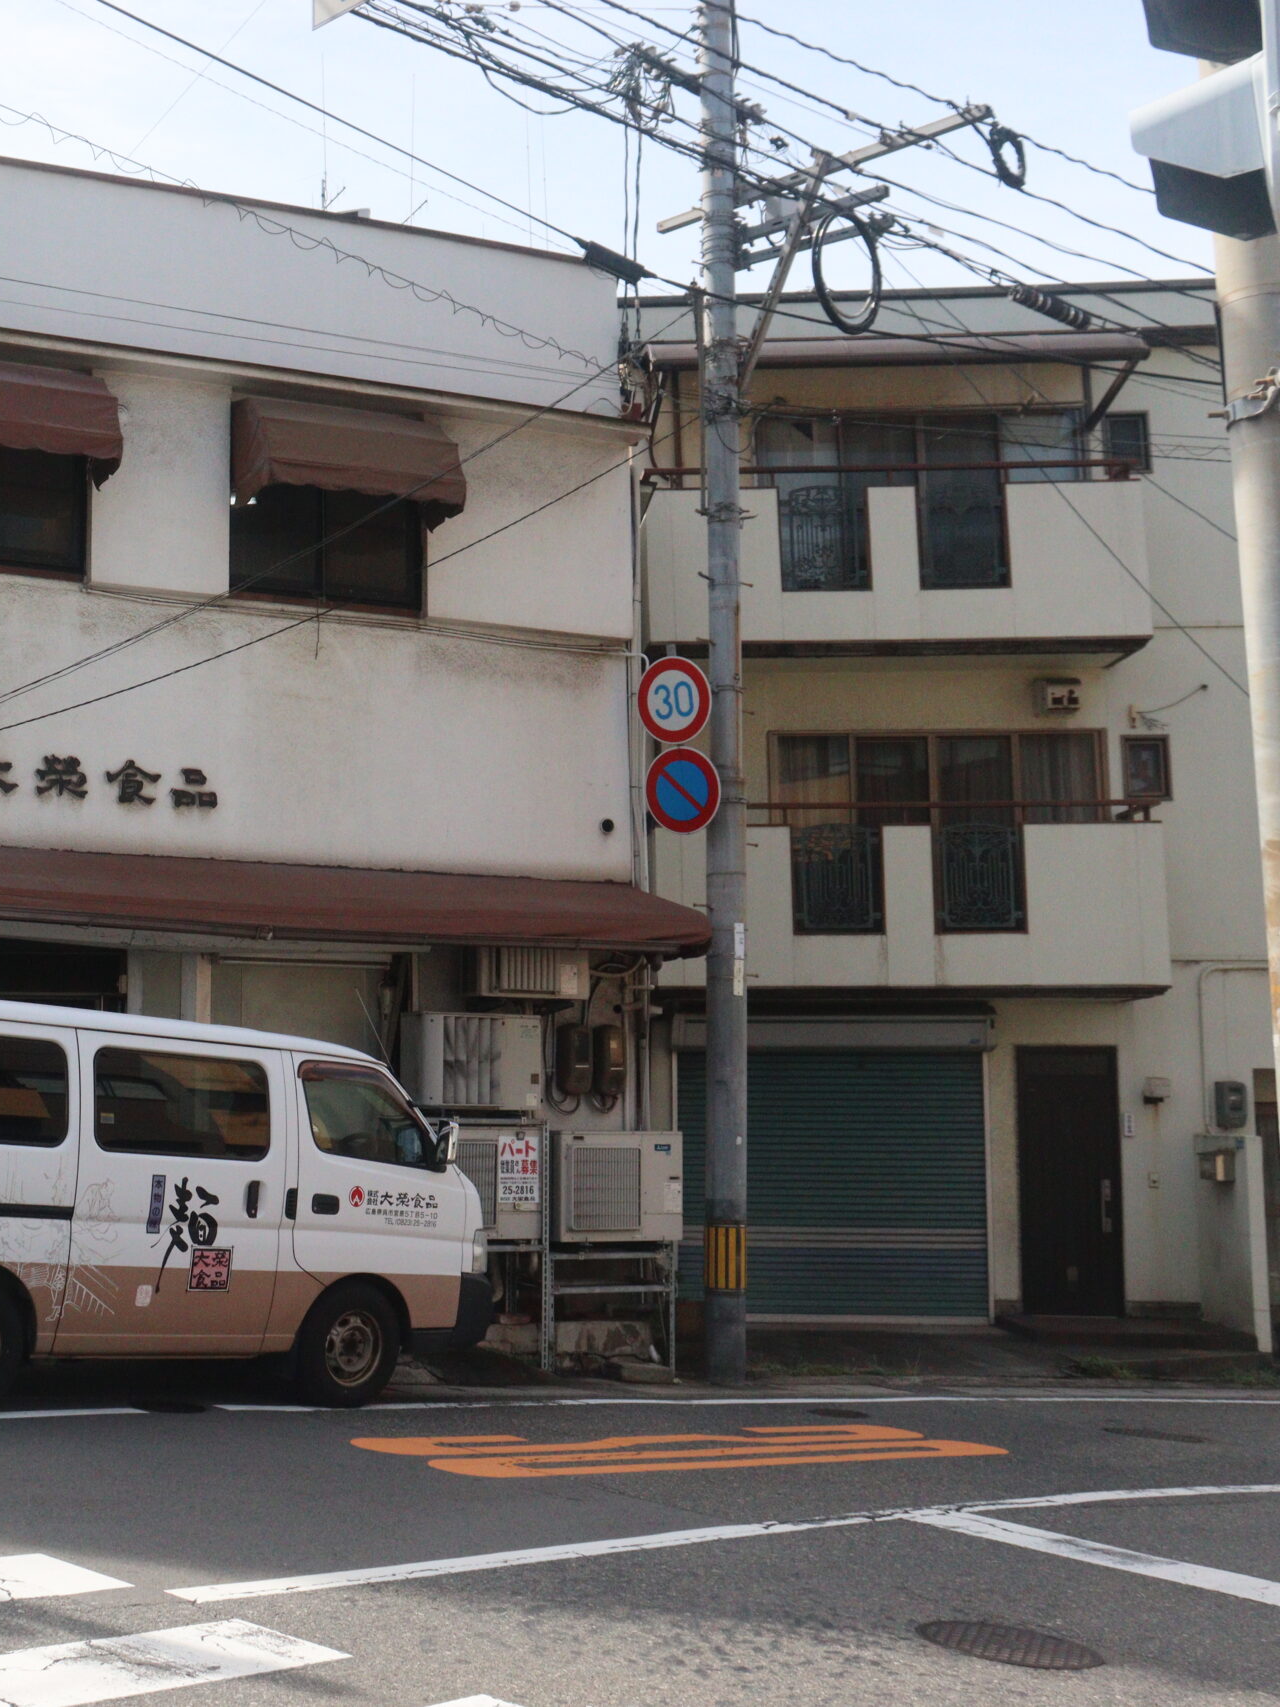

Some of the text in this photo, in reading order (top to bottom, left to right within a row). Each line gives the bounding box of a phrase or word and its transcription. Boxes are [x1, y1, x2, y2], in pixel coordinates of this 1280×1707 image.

[654, 681, 694, 720] 30
[500, 1139, 536, 1157] パート
[502, 1185, 535, 1195] 25-2816
[350, 1424, 1009, 1478] 30
